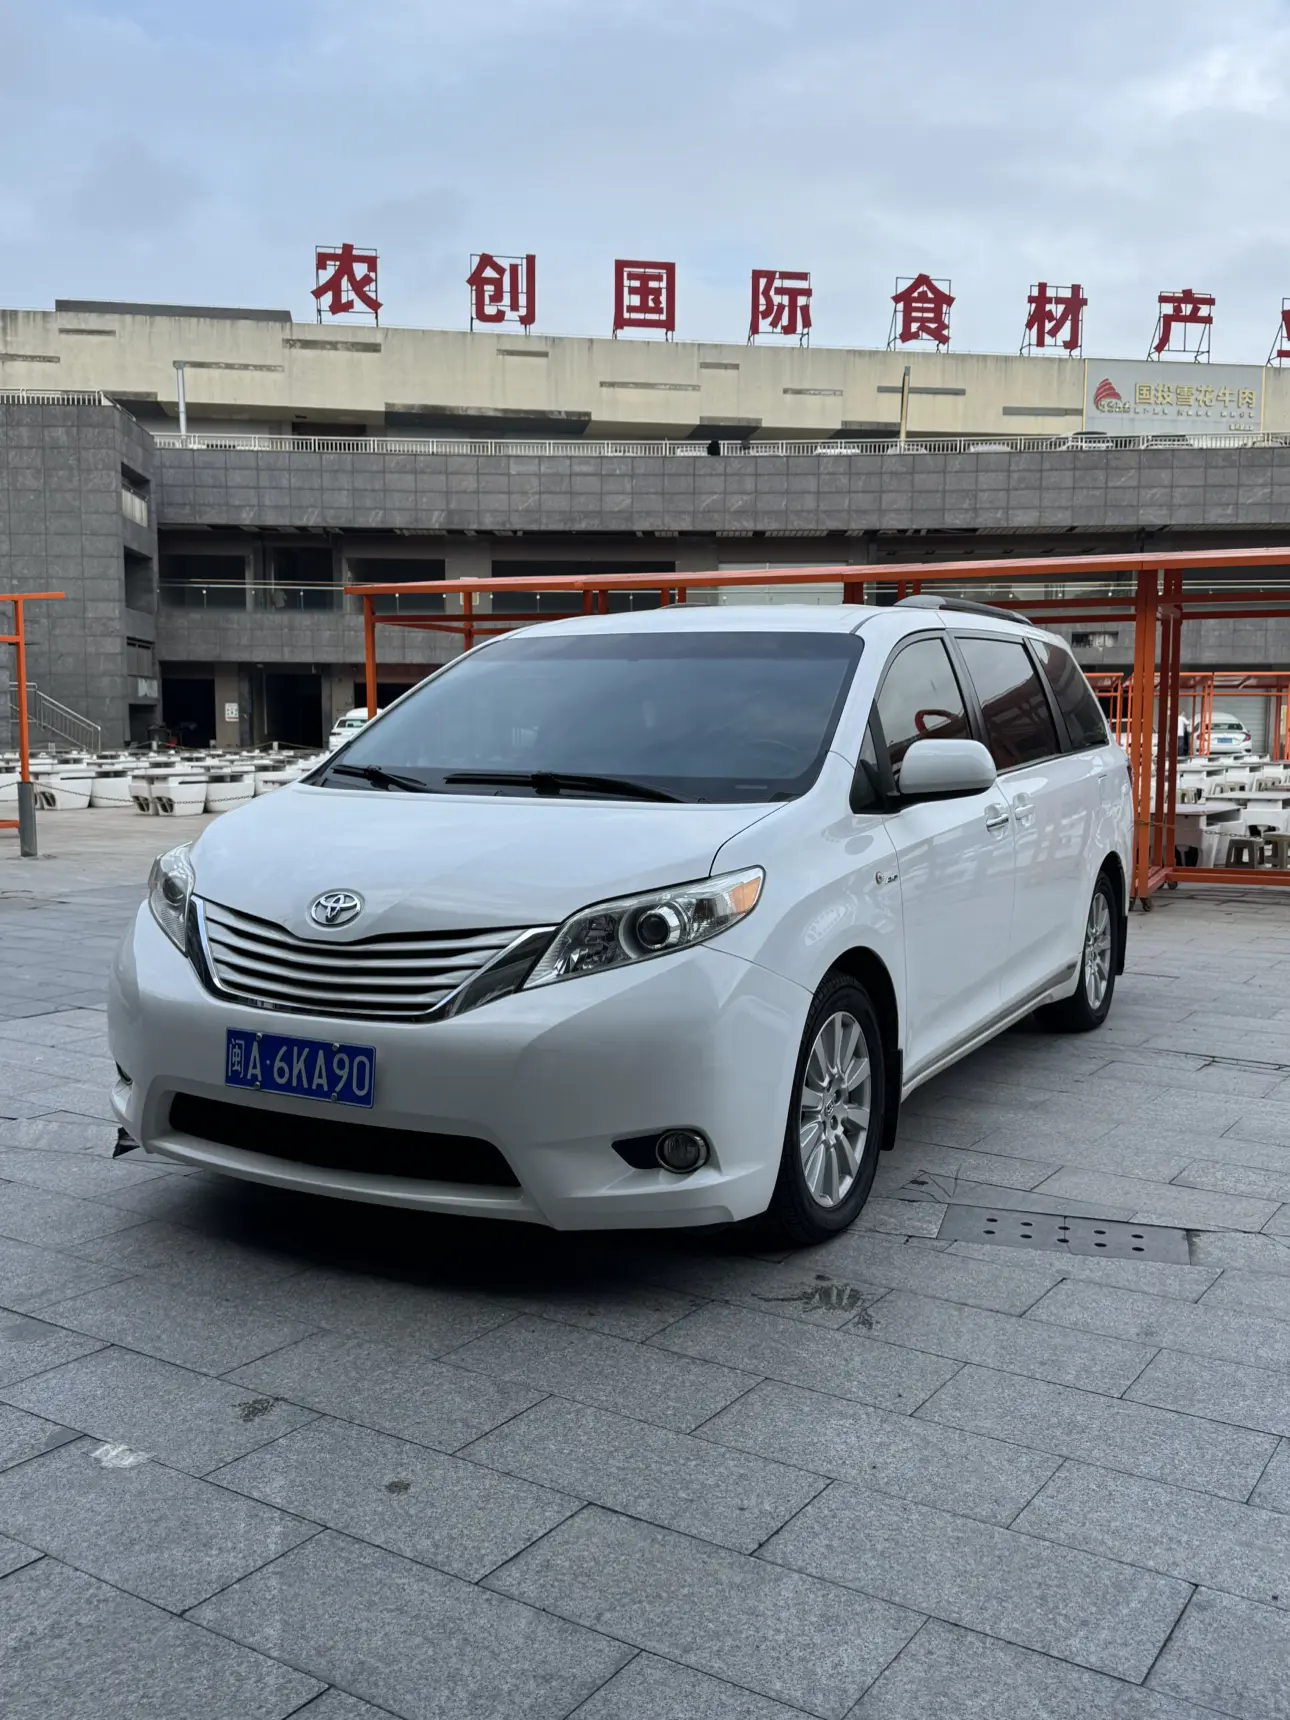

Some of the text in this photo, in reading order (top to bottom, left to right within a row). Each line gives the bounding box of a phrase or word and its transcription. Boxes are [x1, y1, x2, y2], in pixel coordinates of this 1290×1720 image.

[311, 243, 1290, 358] 农创国际食材产
[1135, 383, 1256, 409] 国投雪花牛肉
